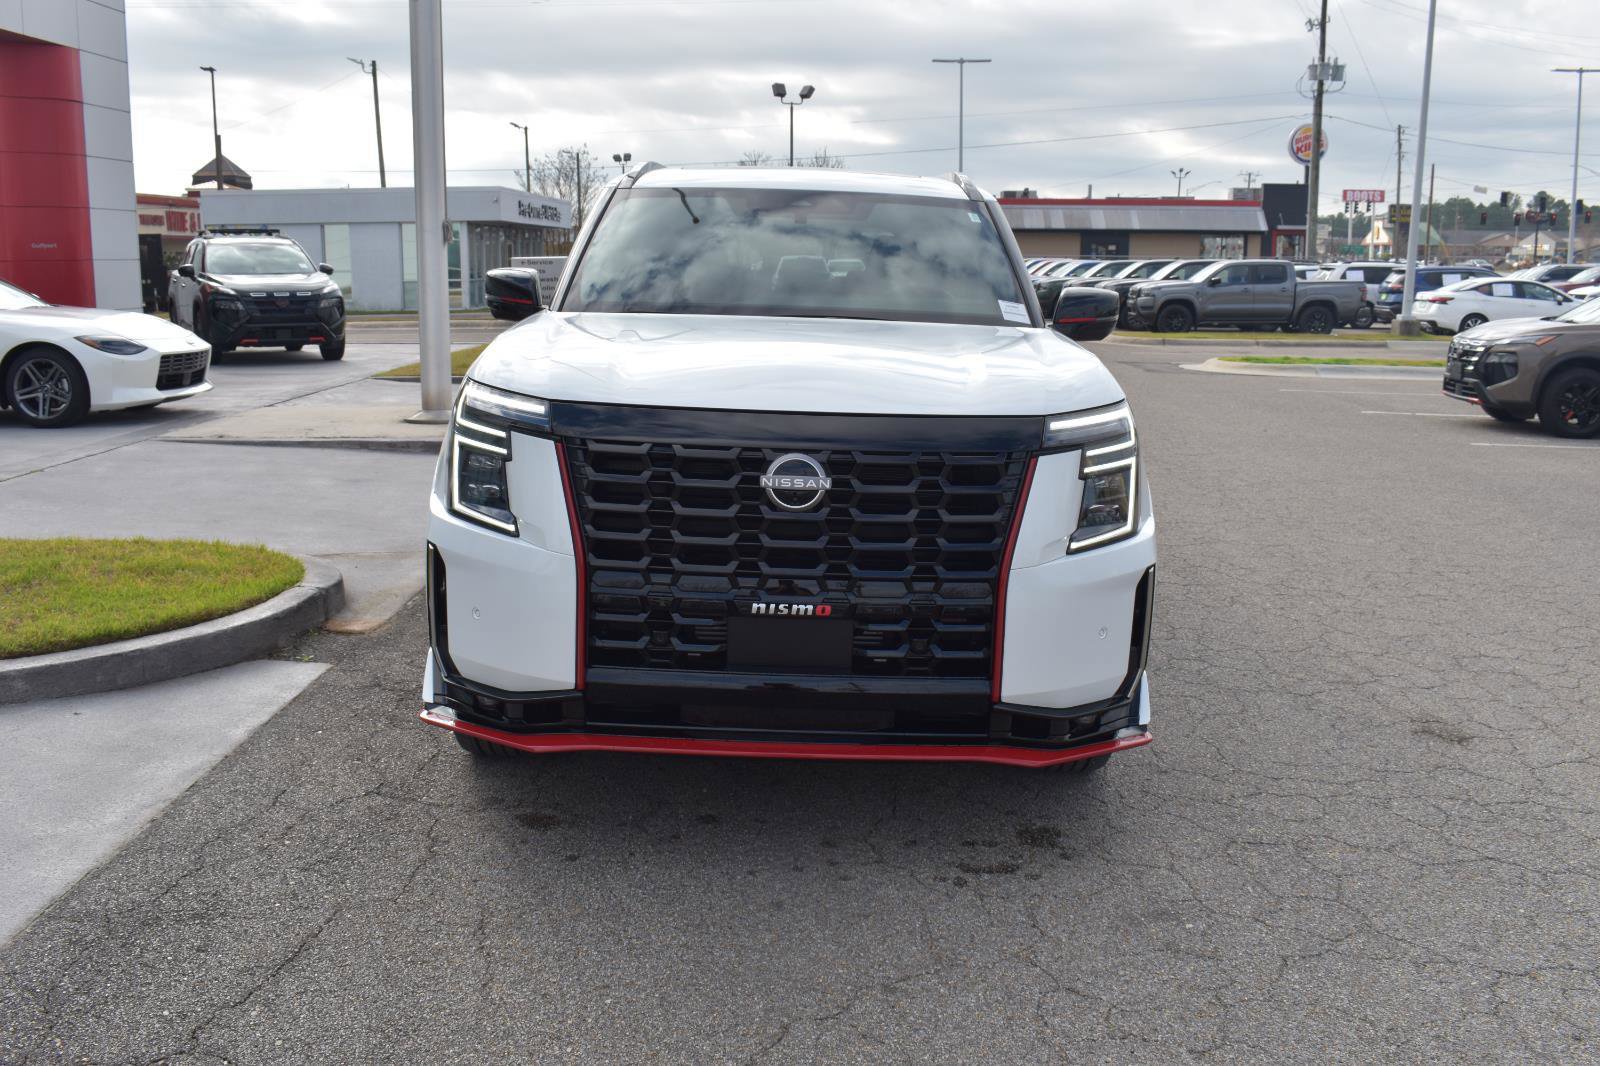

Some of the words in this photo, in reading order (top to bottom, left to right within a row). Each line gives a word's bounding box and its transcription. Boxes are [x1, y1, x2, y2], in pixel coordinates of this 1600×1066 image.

[1347, 190, 1381, 201] BOOTS
[761, 477, 830, 489] NISSAN
[751, 602, 832, 617] nismo
